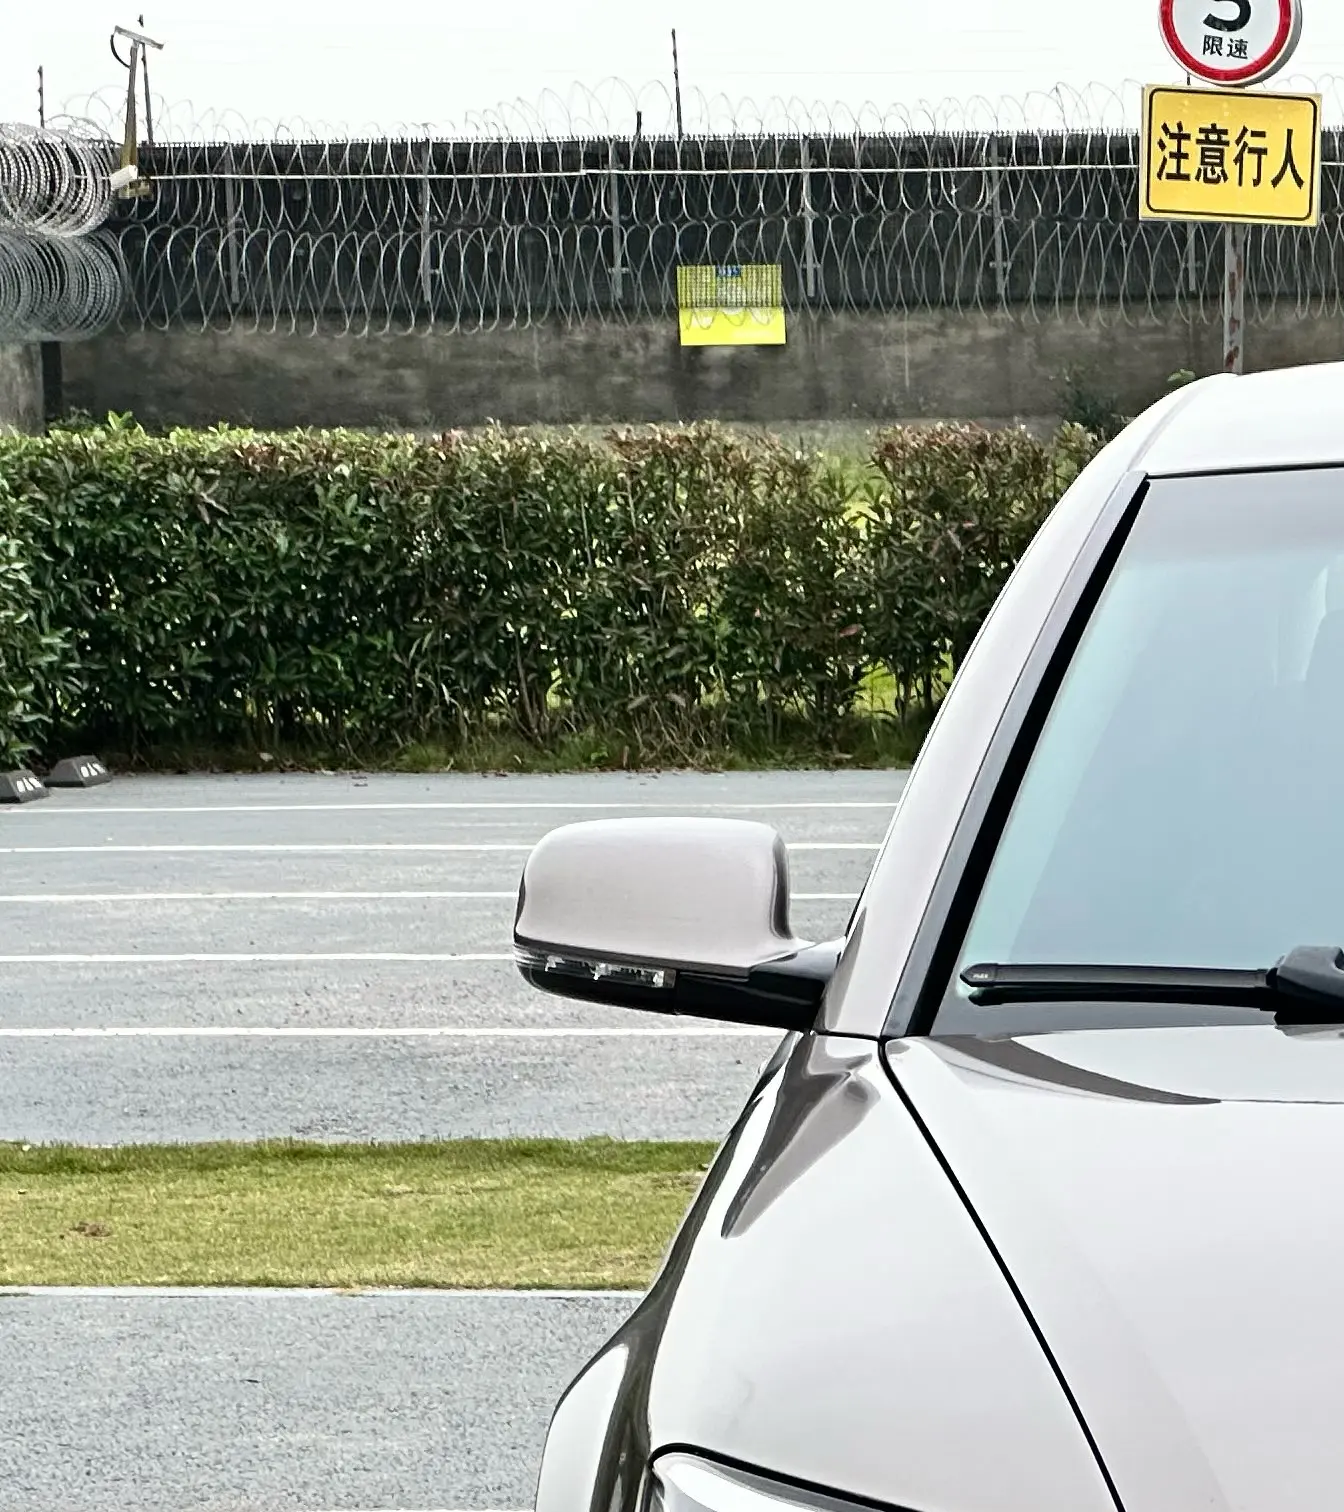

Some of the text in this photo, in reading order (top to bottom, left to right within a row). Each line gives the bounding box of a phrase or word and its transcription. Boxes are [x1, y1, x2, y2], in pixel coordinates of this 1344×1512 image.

[1202, 35, 1248, 59] 限速
[1156, 121, 1304, 190] 注意行人
